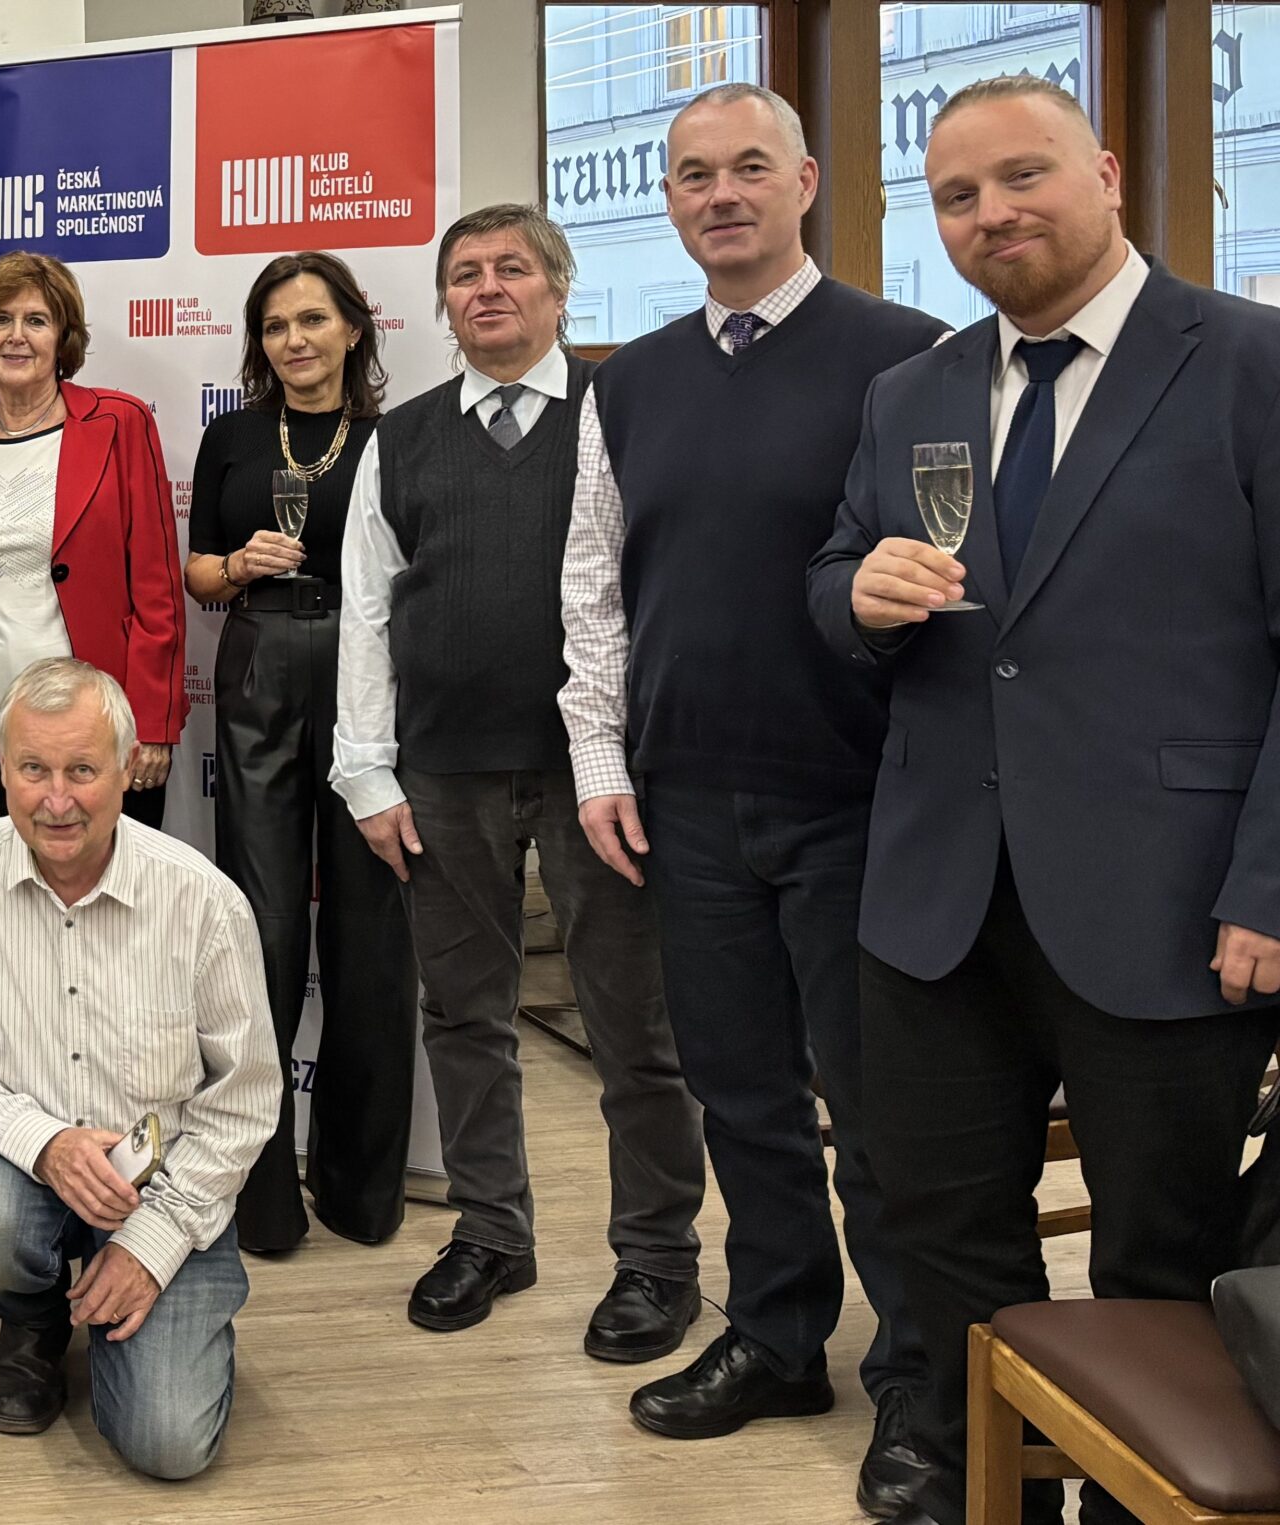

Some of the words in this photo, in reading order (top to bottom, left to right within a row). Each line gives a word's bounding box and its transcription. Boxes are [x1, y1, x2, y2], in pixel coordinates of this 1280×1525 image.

[310, 152, 349, 173] KLUB
[56, 166, 102, 191] ČESKÁ
[309, 171, 373, 198] UČITELŮ
[56, 185, 164, 213] MARKETINGOVÁ
[309, 198, 413, 223] MARKETINGU
[56, 212, 146, 237] SPOLEČNOST
[177, 297, 199, 309] KLUB
[177, 308, 212, 323] UČITELŮ
[177, 324, 233, 337] MARKETINGU
[176, 481, 192, 492] KLU
